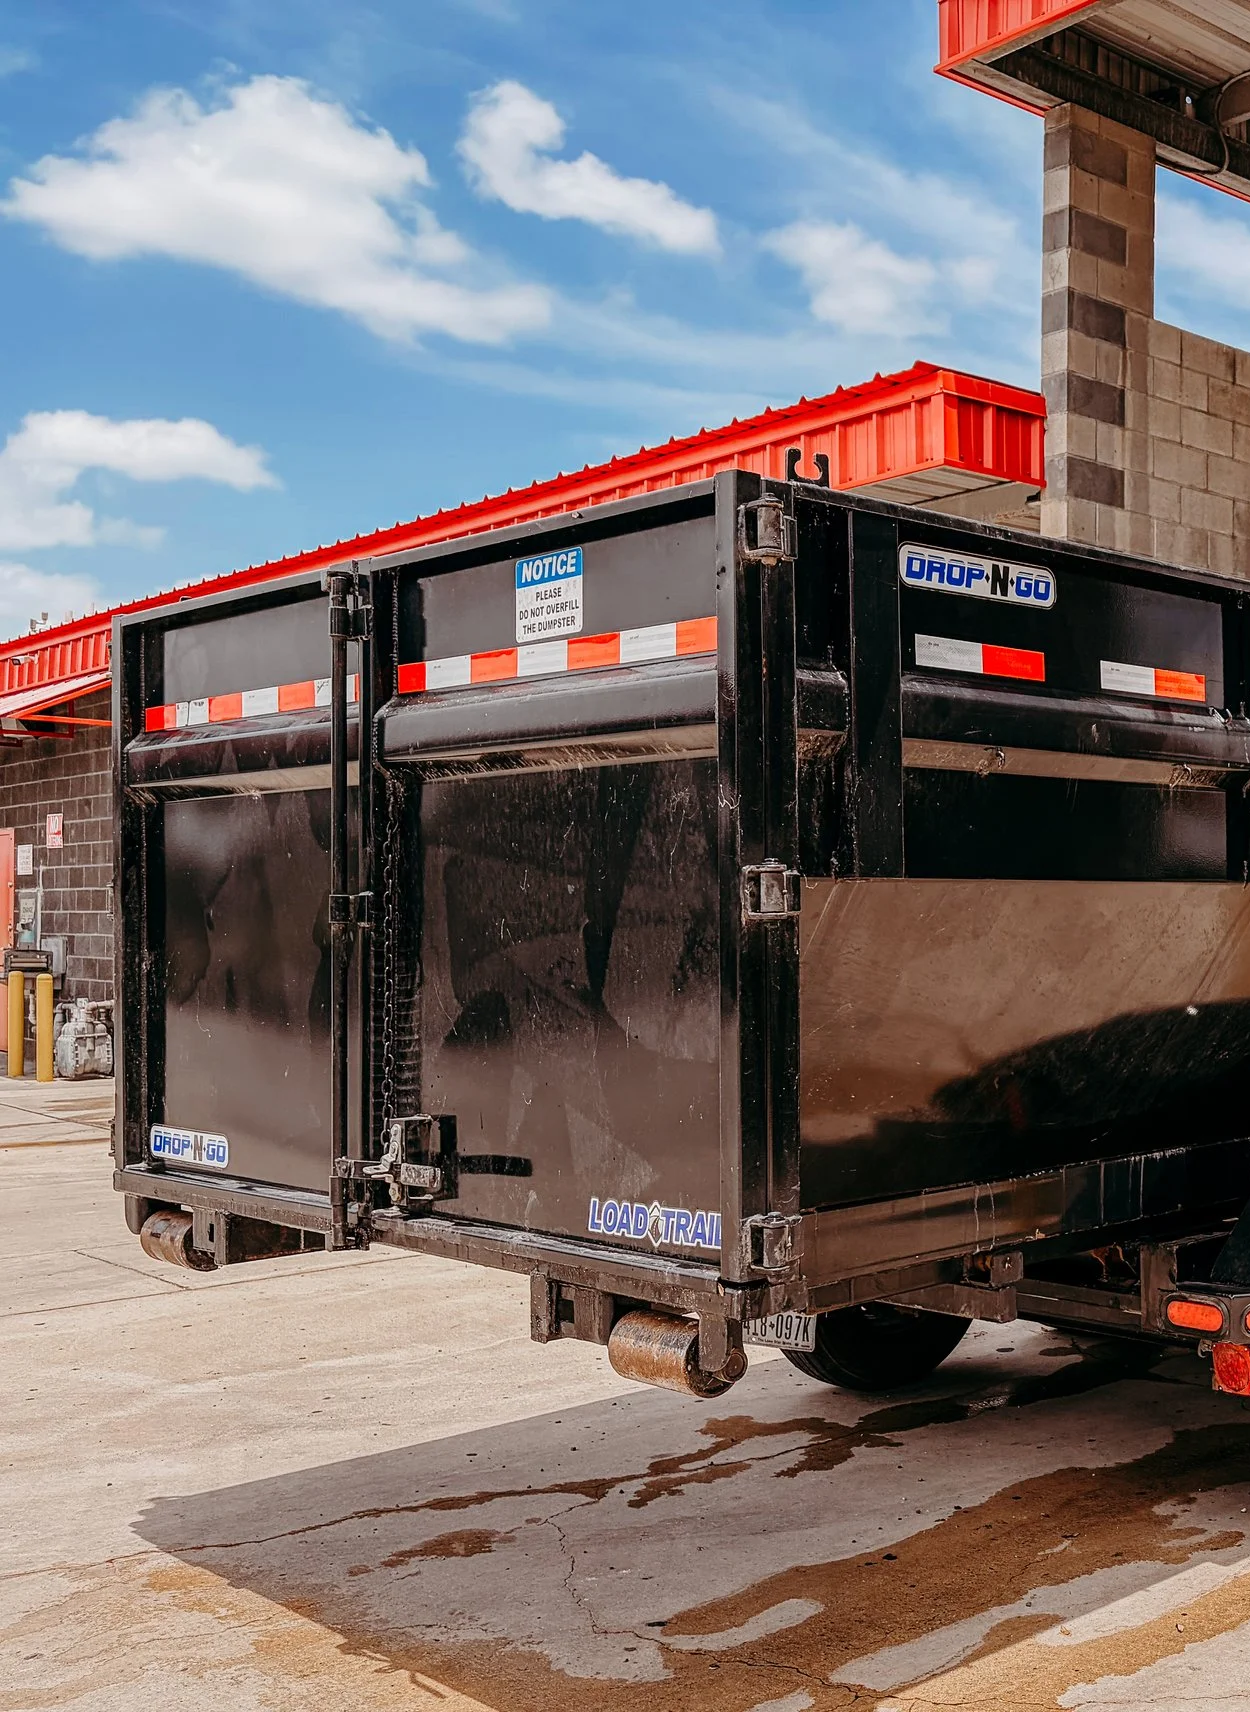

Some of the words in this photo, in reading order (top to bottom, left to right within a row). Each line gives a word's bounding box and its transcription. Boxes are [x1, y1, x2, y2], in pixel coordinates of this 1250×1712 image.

[521, 551, 577, 583] NOTICE
[535, 586, 562, 602] PLEASE
[519, 609, 529, 620] DO
[530, 606, 544, 619] NOT
[546, 599, 580, 615] OVERFILL
[522, 623, 536, 635] THE
[538, 615, 576, 632] DUMPSTER
[589, 1197, 649, 1238] LOAD
